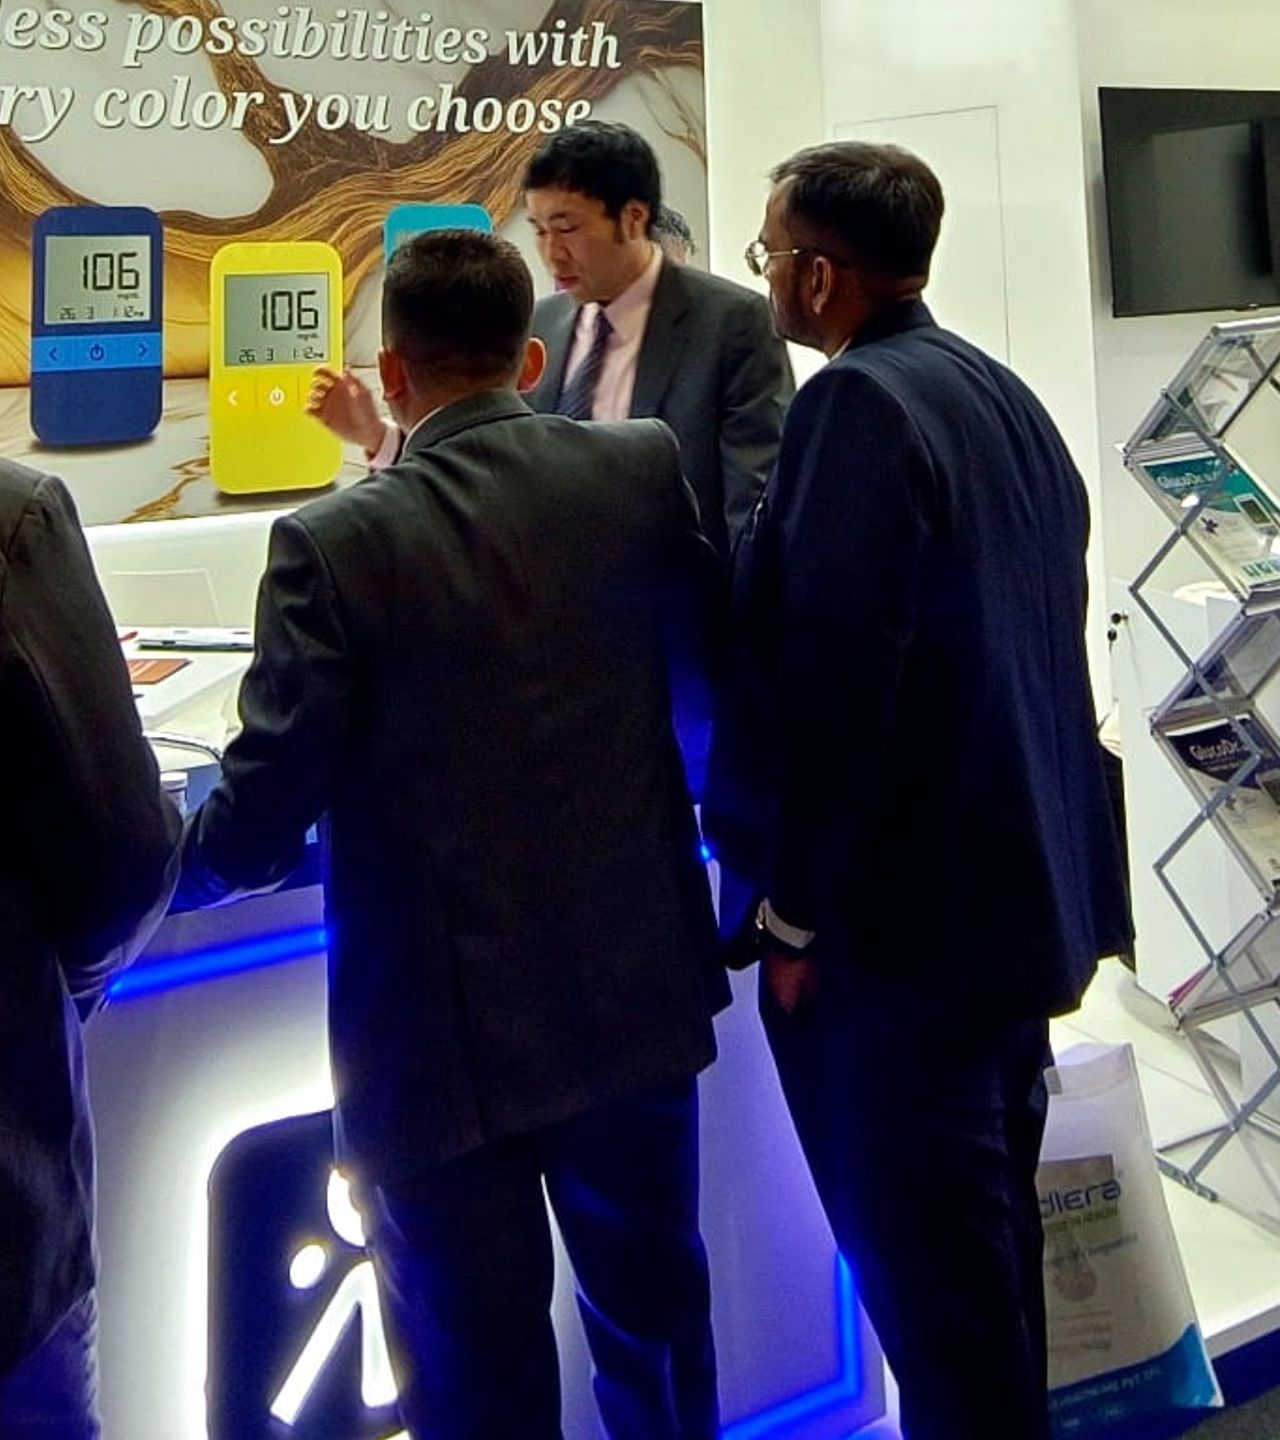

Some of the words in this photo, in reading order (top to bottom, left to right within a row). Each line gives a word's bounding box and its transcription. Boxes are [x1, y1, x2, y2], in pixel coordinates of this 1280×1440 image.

[122, 5, 491, 69] possibilities
[505, 19, 622, 70] with
[93, 74, 265, 131] color
[270, 88, 393, 145] you
[406, 82, 592, 134] choose
[83, 252, 139, 291] 106
[262, 290, 319, 331] 106
[266, 347, 274, 361] 3
